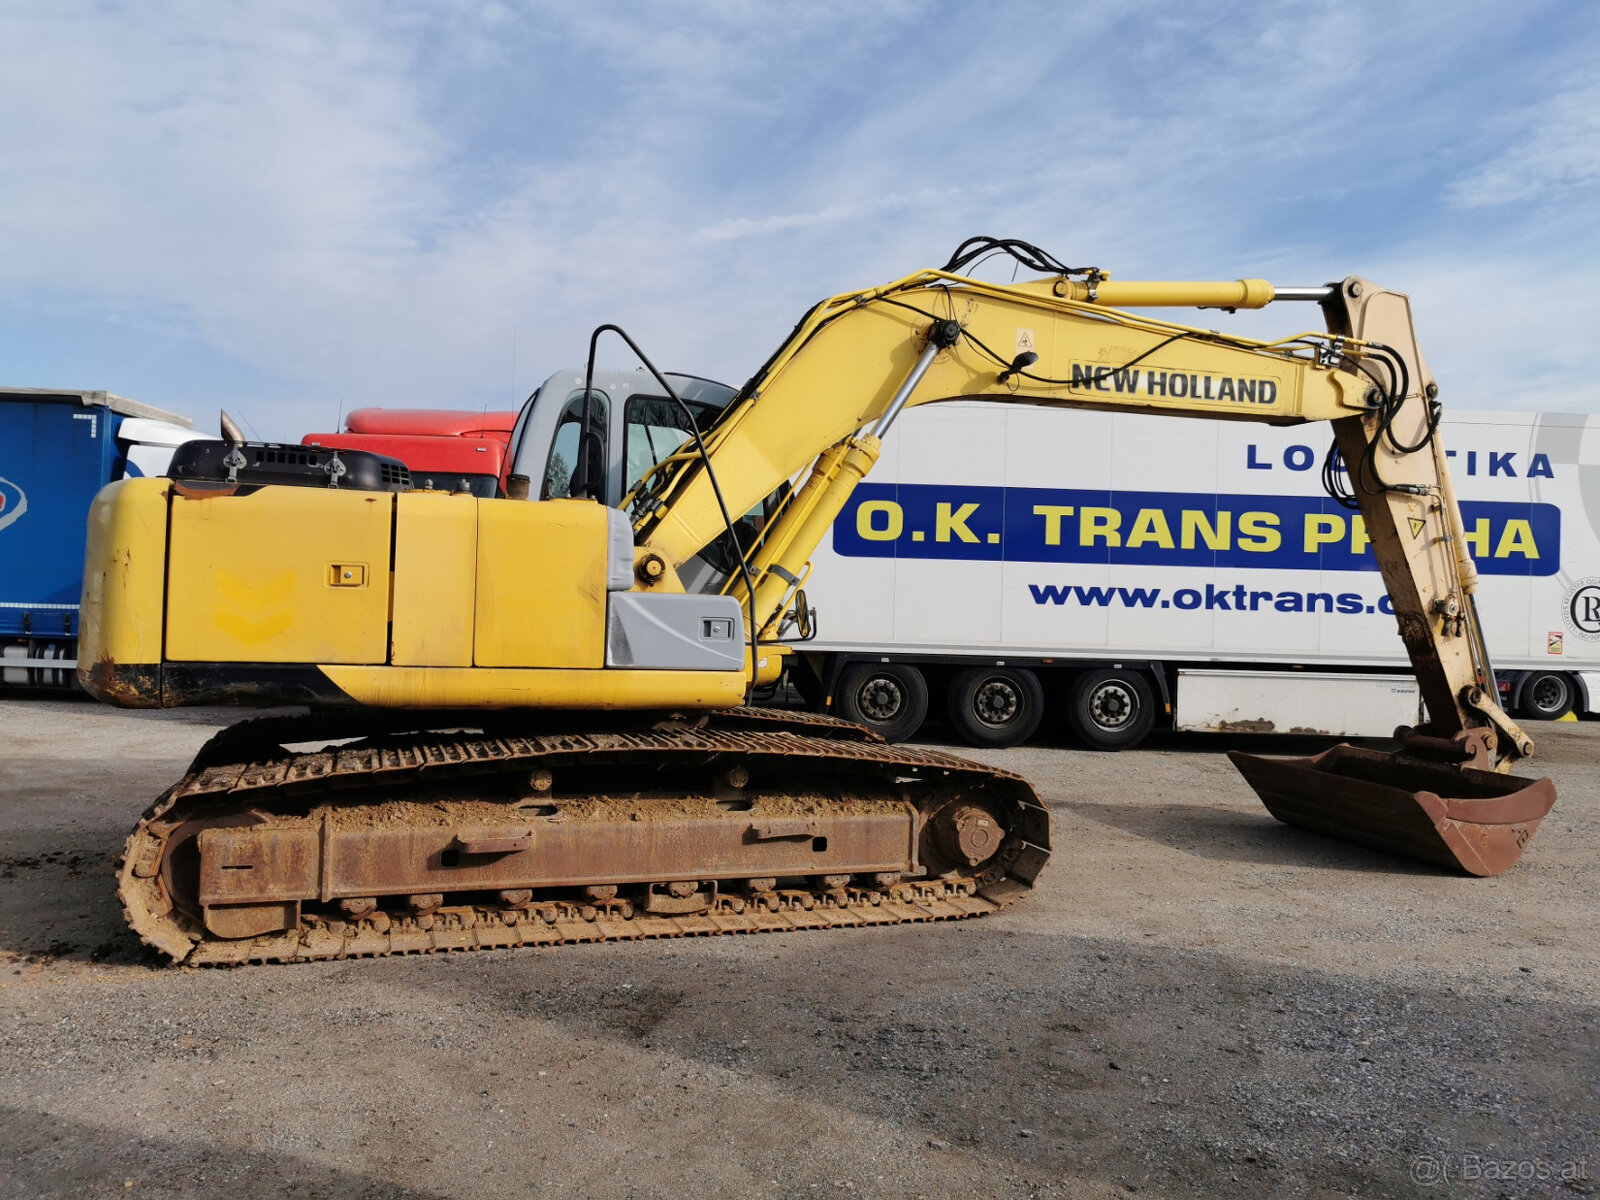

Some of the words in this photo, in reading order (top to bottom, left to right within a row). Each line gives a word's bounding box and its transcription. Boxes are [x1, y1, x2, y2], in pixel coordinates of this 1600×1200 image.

[1072, 363, 1140, 394] NEW
[1147, 371, 1277, 405] HOLLAND
[857, 500, 1000, 544] O.K.
[1033, 505, 1282, 554] TRANS
